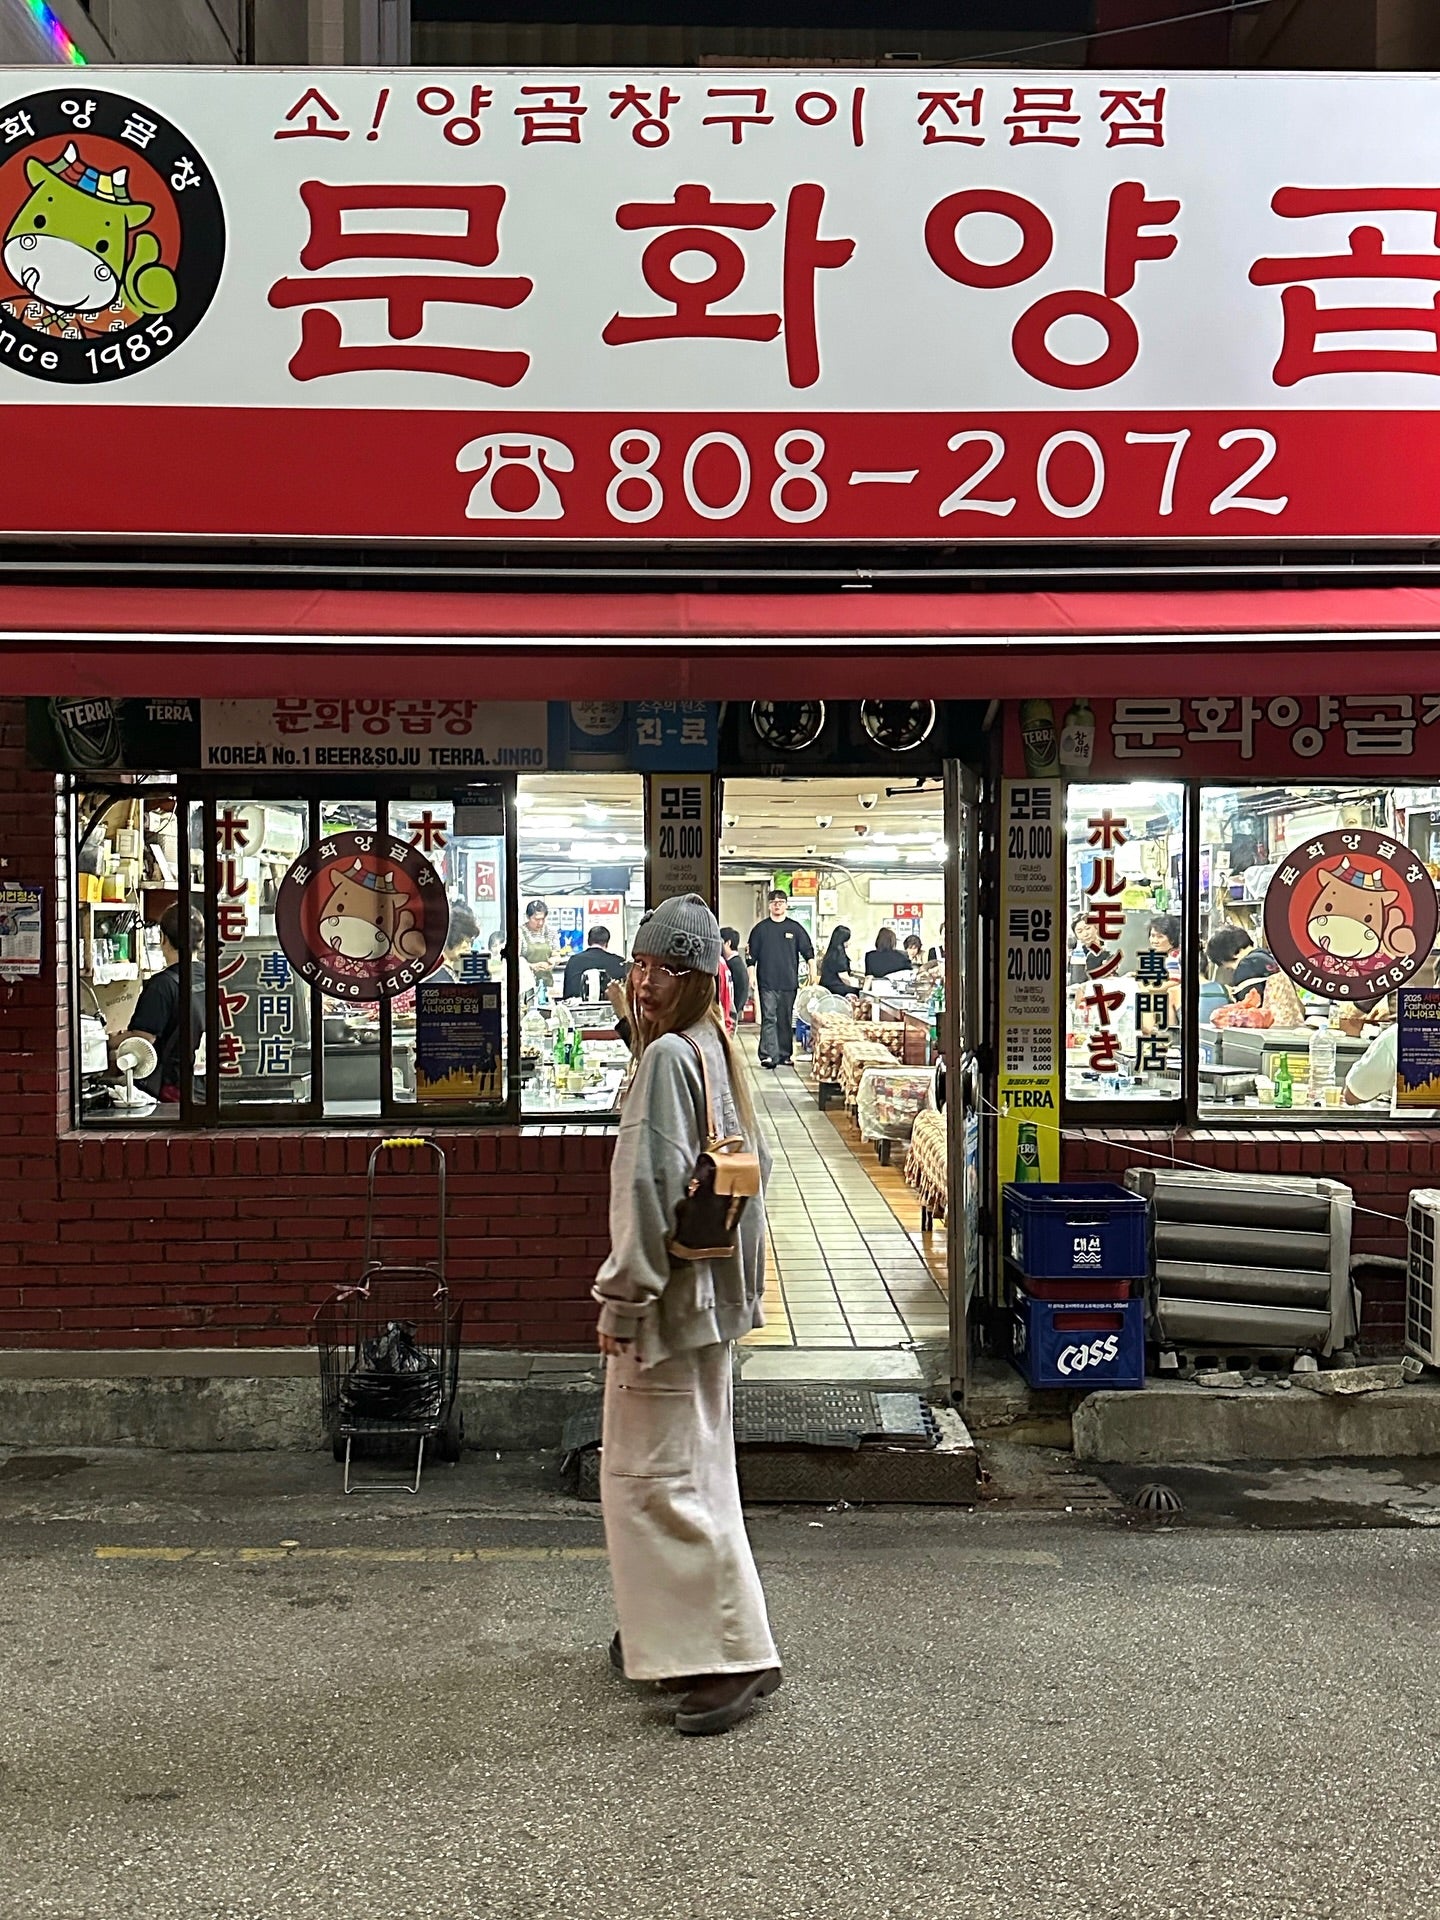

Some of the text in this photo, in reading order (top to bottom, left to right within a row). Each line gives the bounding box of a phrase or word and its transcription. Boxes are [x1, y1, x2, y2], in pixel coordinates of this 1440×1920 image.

[917, 86, 1167, 149] 전문점
[85, 316, 174, 375] 1985
[605, 428, 1289, 524] 808-2072
[61, 699, 114, 729] TERRA
[145, 705, 193, 722] TERRA
[208, 746, 267, 765] KOREA
[315, 747, 421, 766] BEER&SOJU
[661, 787, 702, 820] 모듬
[1010, 787, 1052, 820] 모듬
[659, 826, 703, 859] 20,000
[1008, 826, 1052, 859] 20,000
[291, 835, 434, 885] 문화양곱창
[1278, 834, 1424, 887] 문화양곱창
[477, 863, 494, 897] A-6
[896, 904, 919, 916] B-8
[1009, 909, 1052, 942] 특양
[1086, 808, 1128, 1075] ホルモンヤき
[302, 958, 426, 996] Since 1985
[1007, 947, 1052, 981] 20,000
[1291, 955, 1416, 996] Since 1985
[1403, 994, 1422, 1002] 2025
[1403, 1003, 1437, 1011] Fashion
[1001, 1089, 1054, 1109] TERRA
